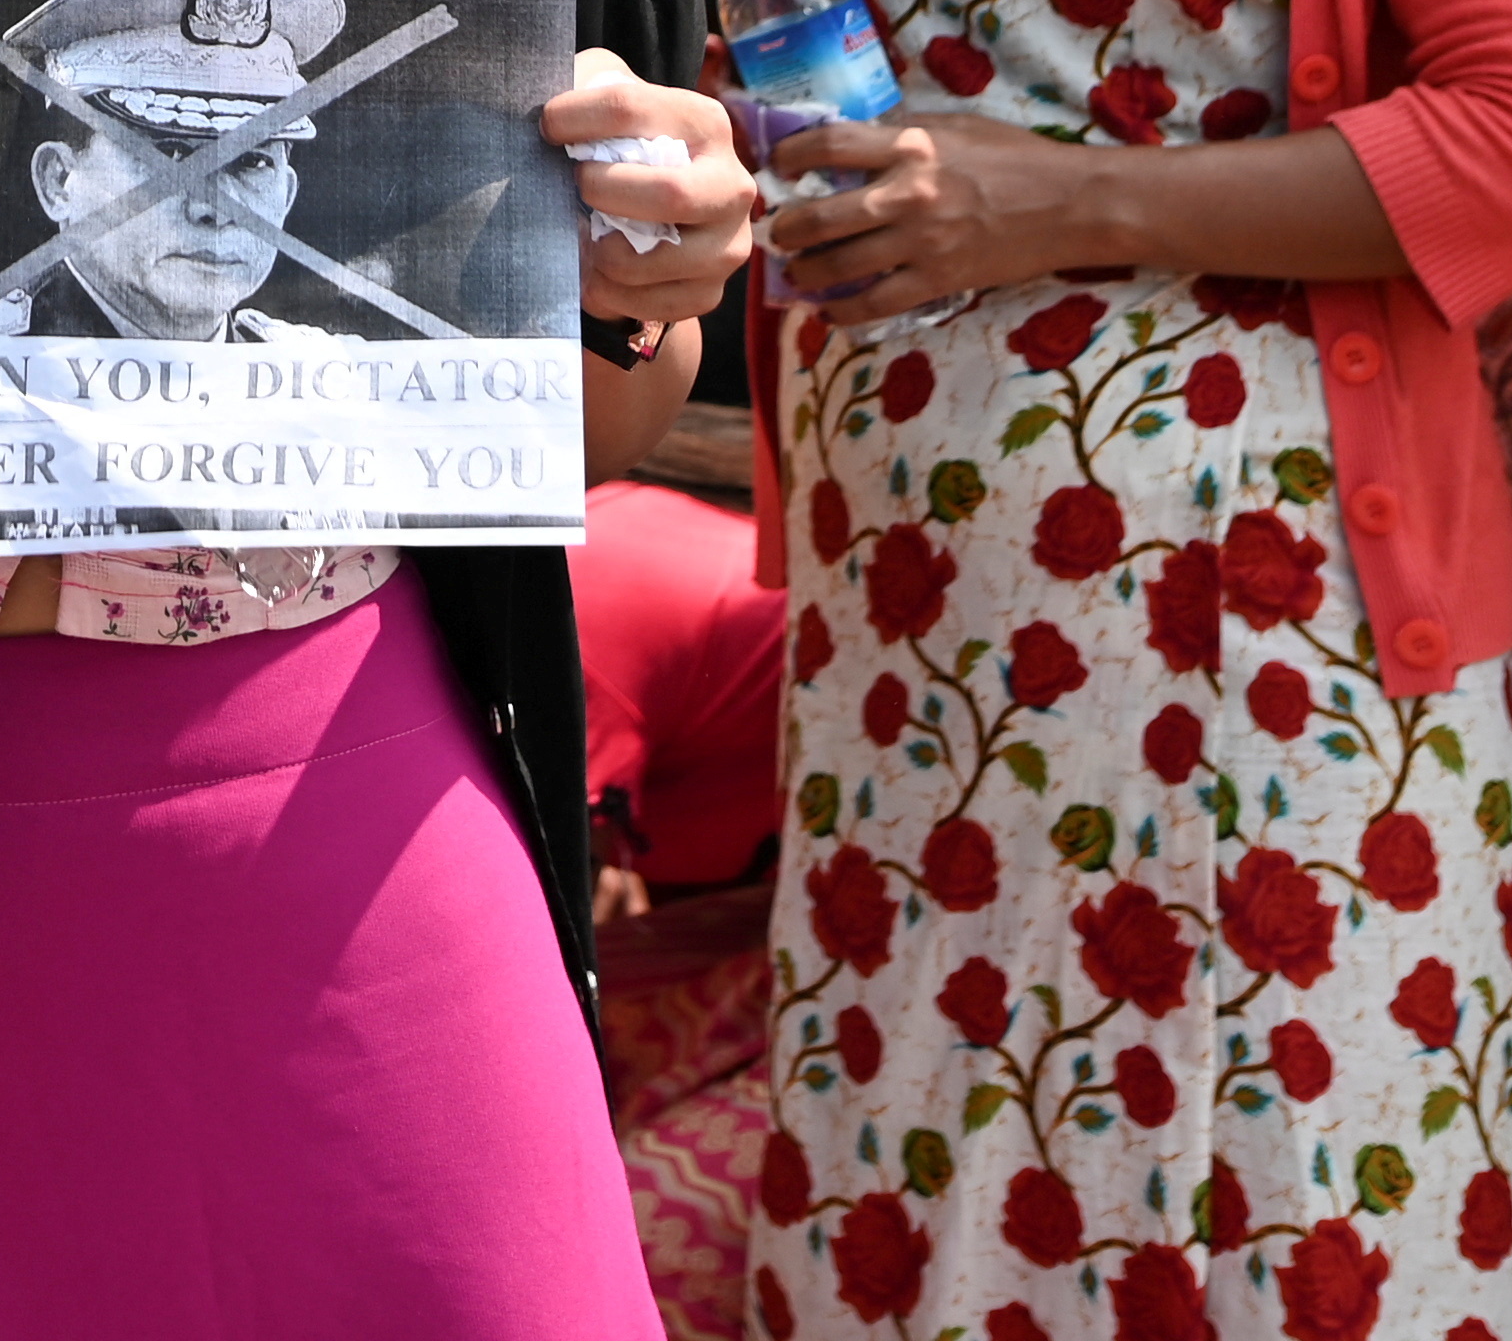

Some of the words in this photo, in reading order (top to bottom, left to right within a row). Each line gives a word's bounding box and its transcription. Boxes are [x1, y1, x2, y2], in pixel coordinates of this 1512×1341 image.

[66, 355, 211, 409] YOU,
[245, 358, 574, 403] DICTATOR
[93, 440, 377, 487] FORGIVE
[414, 445, 546, 490] YOU
